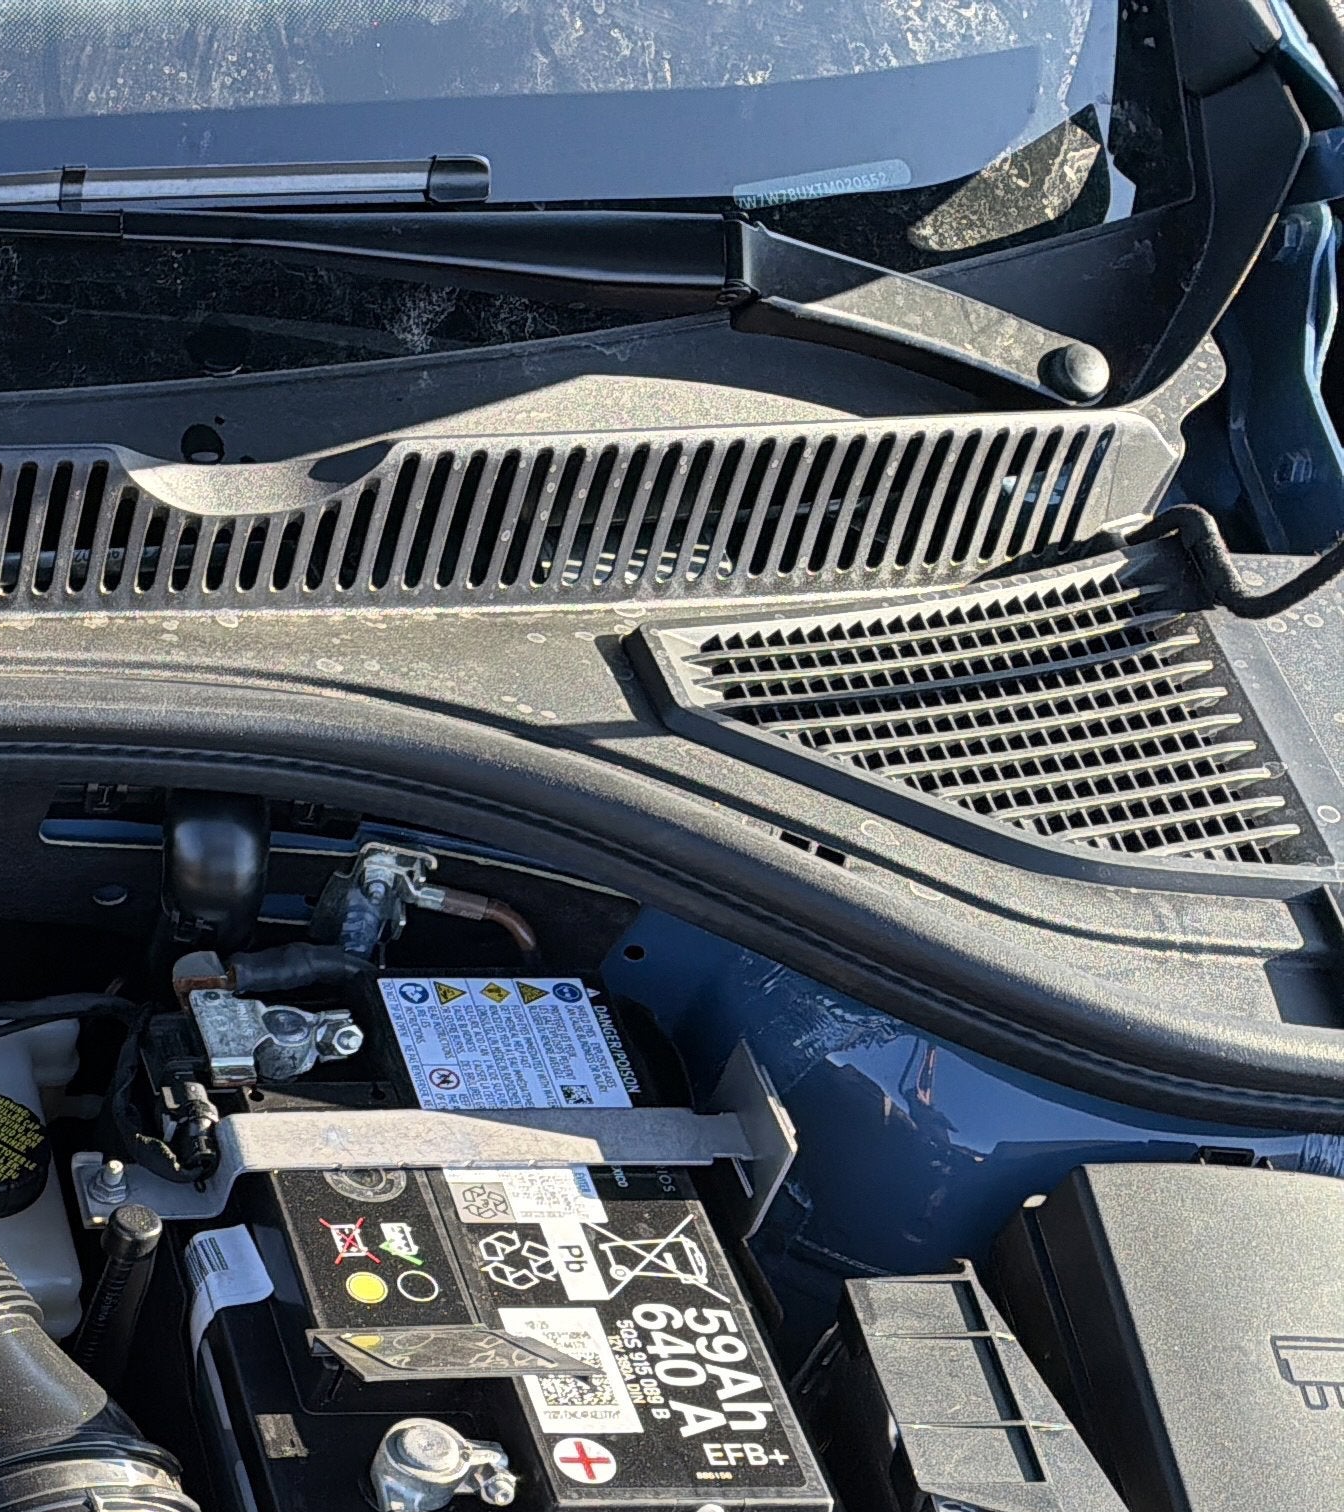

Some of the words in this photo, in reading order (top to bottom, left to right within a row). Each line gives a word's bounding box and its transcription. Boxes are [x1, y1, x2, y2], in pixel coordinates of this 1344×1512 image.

[420, 1019, 430, 1028] LES
[425, 1005, 439, 1019] READ
[451, 1005, 465, 1022] CAUSE
[458, 1023, 476, 1052] BLINDNESS
[503, 1016, 520, 1038] MEDICAL
[512, 1040, 526, 1054] HELP
[537, 1005, 550, 1014] LES
[546, 1026, 565, 1054] EXPLOSIFS
[558, 1055, 576, 1079] PEUVENT
[559, 1033, 571, 1042] LES
[575, 1004, 590, 1023] SHIELD
[589, 1042, 610, 1070] EXPLOSIVE
[477, 1045, 489, 1056] CAN
[510, 1004, 524, 1022] FLUSH
[518, 1023, 530, 1035] EYES
[537, 1074, 550, 1087] WITH
[569, 1016, 583, 1032] CAUSE
[576, 1034, 596, 1062] BLINDNESS
[588, 1064, 600, 1072] OR
[592, 1005, 641, 1092] DANGER/POISON
[22, 1118, 40, 1132] CAP
[26, 1129, 44, 1143] USE
[14, 1132, 37, 1149] FROM
[6, 1168, 19, 1180] DU
[23, 1159, 36, 1171] LE
[560, 1245, 587, 1273] Pb
[632, 1305, 707, 1386] 640
[606, 1336, 626, 1352] 12V
[627, 1384, 647, 1404] DIN
[628, 1352, 654, 1375] 915
[685, 1307, 773, 1431] 59Ah
[667, 1401, 732, 1438] A
[703, 1443, 790, 1467] EFB+
